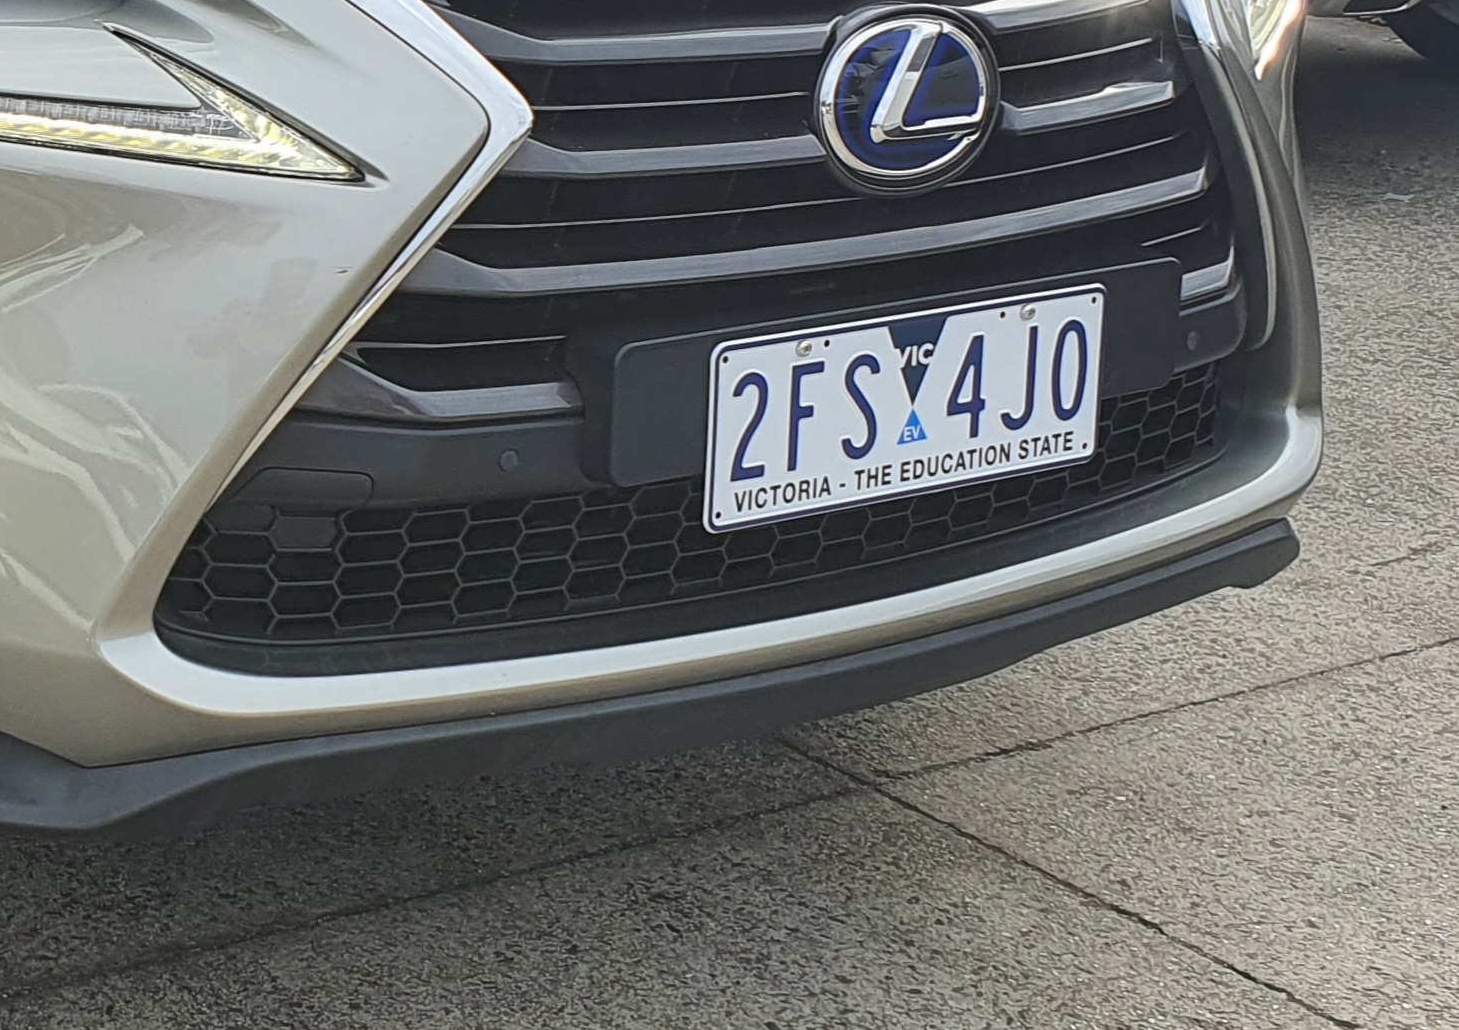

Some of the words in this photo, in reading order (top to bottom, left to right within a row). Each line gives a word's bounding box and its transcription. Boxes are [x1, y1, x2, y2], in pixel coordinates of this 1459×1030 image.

[730, 353, 881, 482] 2FS
[902, 424, 921, 442] EV
[733, 476, 832, 512] VICTORIA
[854, 464, 892, 491] THE
[899, 441, 1011, 482] EDUCATION
[1017, 431, 1074, 460] STATE
